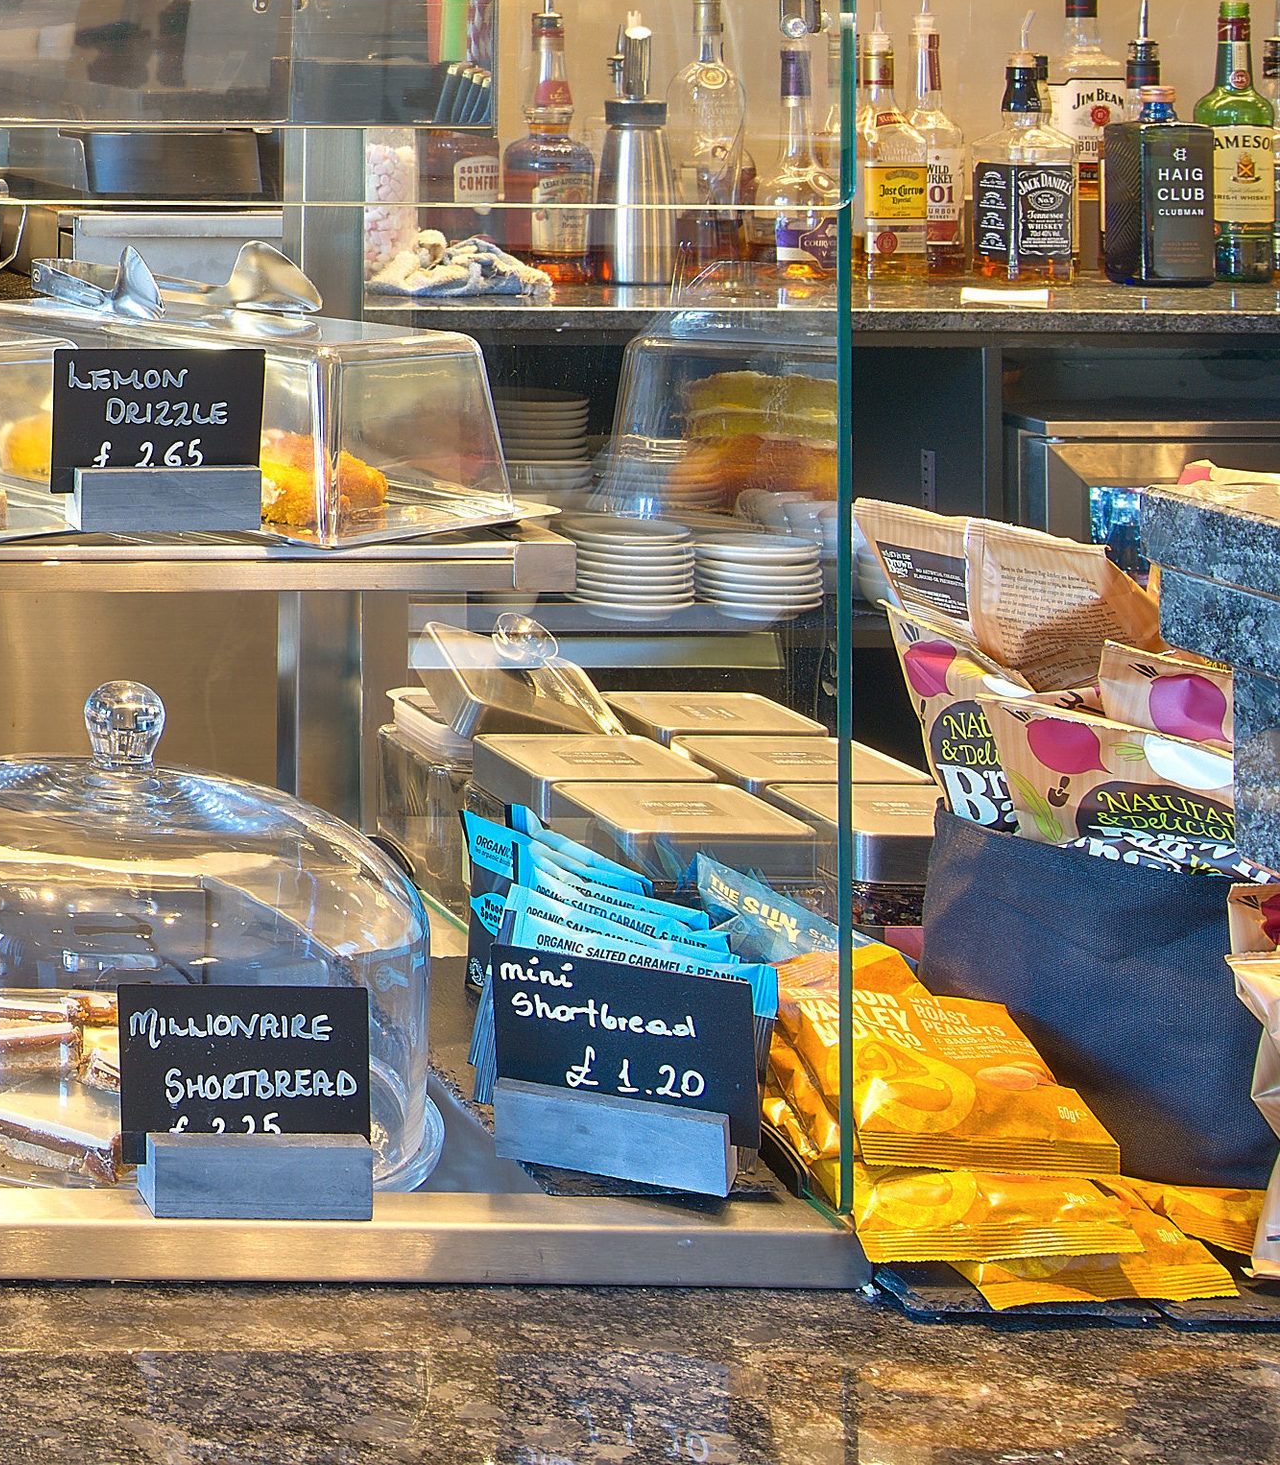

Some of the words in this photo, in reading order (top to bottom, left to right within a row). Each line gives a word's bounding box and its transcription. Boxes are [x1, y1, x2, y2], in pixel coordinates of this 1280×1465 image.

[1073, 93, 1095, 110] JIM
[1096, 87, 1125, 108] BEAM
[1214, 135, 1273, 151] AMESO
[1018, 176, 1041, 195] JACK
[1158, 169, 1203, 181] HAIG
[879, 184, 899, 197] Jose
[898, 185, 924, 196] Cuervo
[1157, 188, 1205, 201] CLUB
[1027, 210, 1064, 219] Tennessee
[1158, 208, 1204, 216] CLUBMAN
[68, 361, 188, 391] LEMON
[105, 398, 230, 426] DRIZZLE
[710, 874, 739, 906] THE
[608, 911, 657, 938] CARAMEL
[536, 933, 583, 954] ORGANIC
[586, 945, 627, 963] SALTED
[628, 954, 682, 973] CARAMEL
[500, 956, 574, 989] mini
[129, 1007, 334, 1049] MILLIONAIRE
[798, 1000, 910, 1031] VALEY
[914, 1006, 968, 1027] ROAST
[923, 1020, 1007, 1038] PEANUTS
[565, 1045, 599, 1089] £
[617, 1058, 706, 1098] 1.20
[164, 1068, 358, 1107] SHORTBREAD
